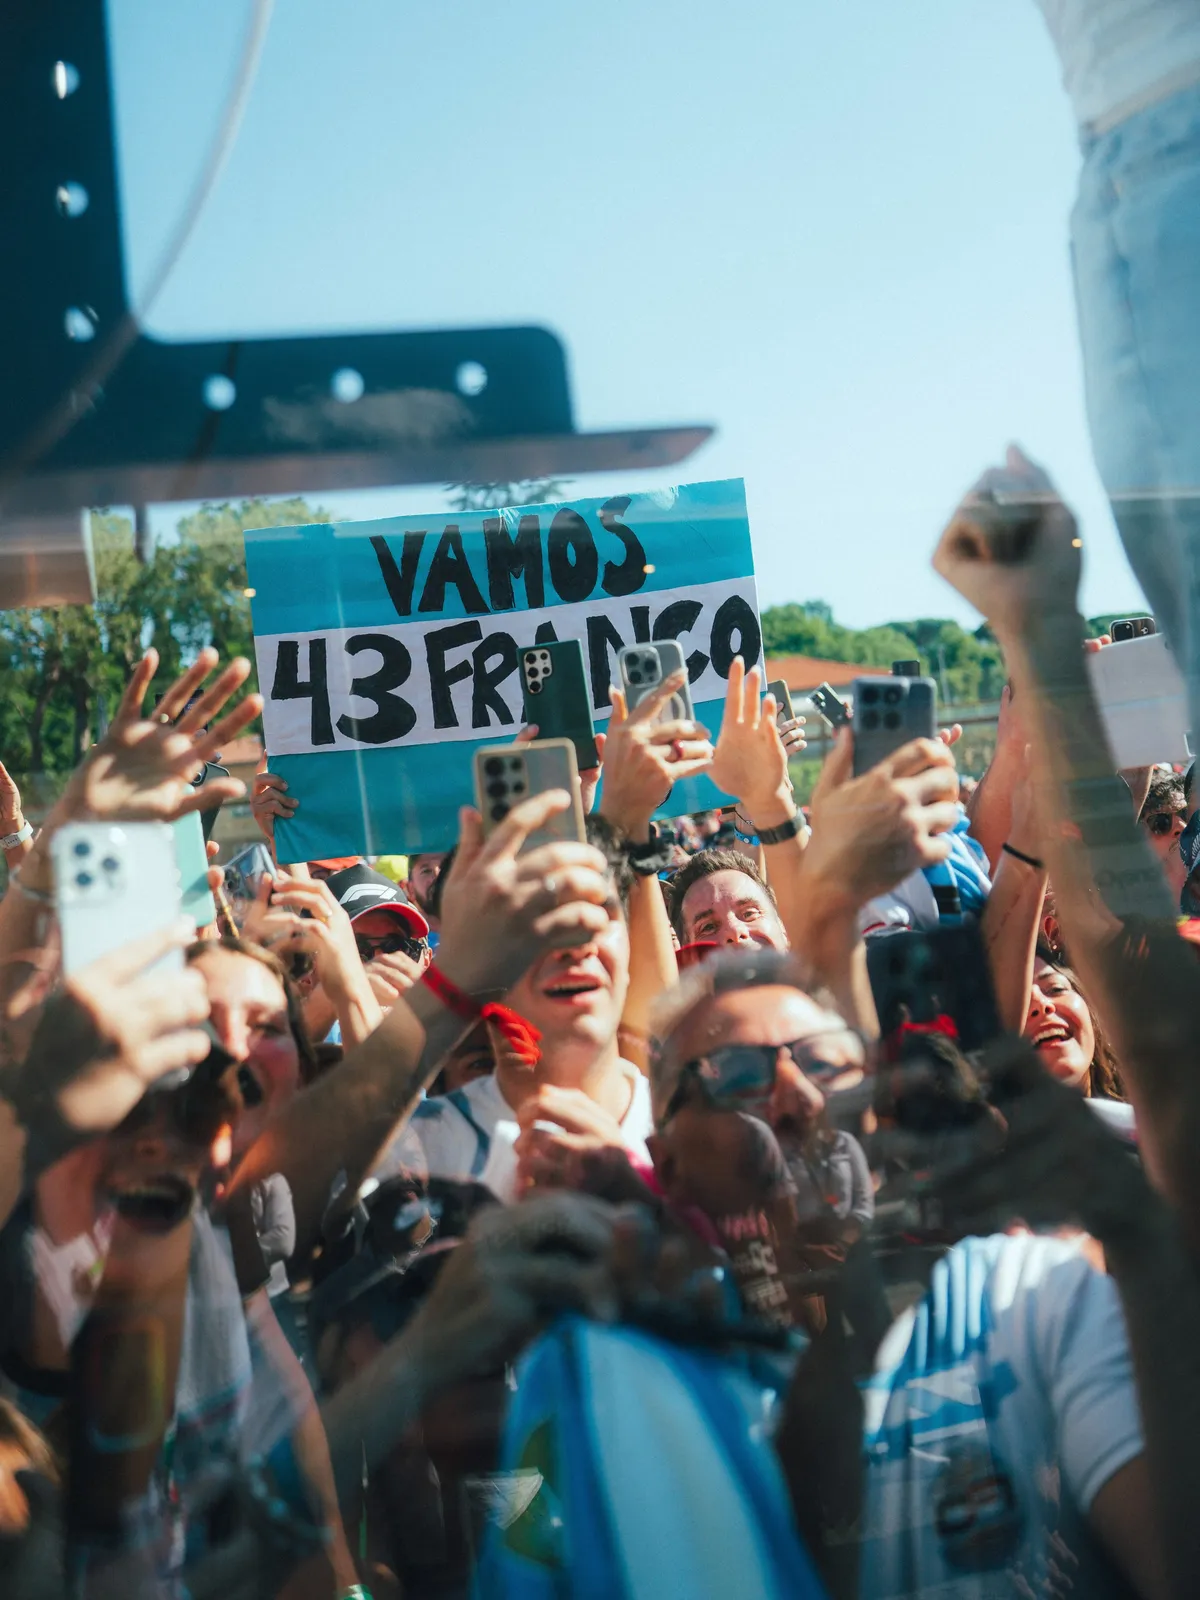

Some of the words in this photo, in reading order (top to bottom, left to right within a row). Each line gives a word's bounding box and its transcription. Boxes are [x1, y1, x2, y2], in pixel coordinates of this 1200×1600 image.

[369, 496, 647, 615] VAMOS
[270, 633, 417, 745] 43
[423, 595, 761, 729] FRNCO
